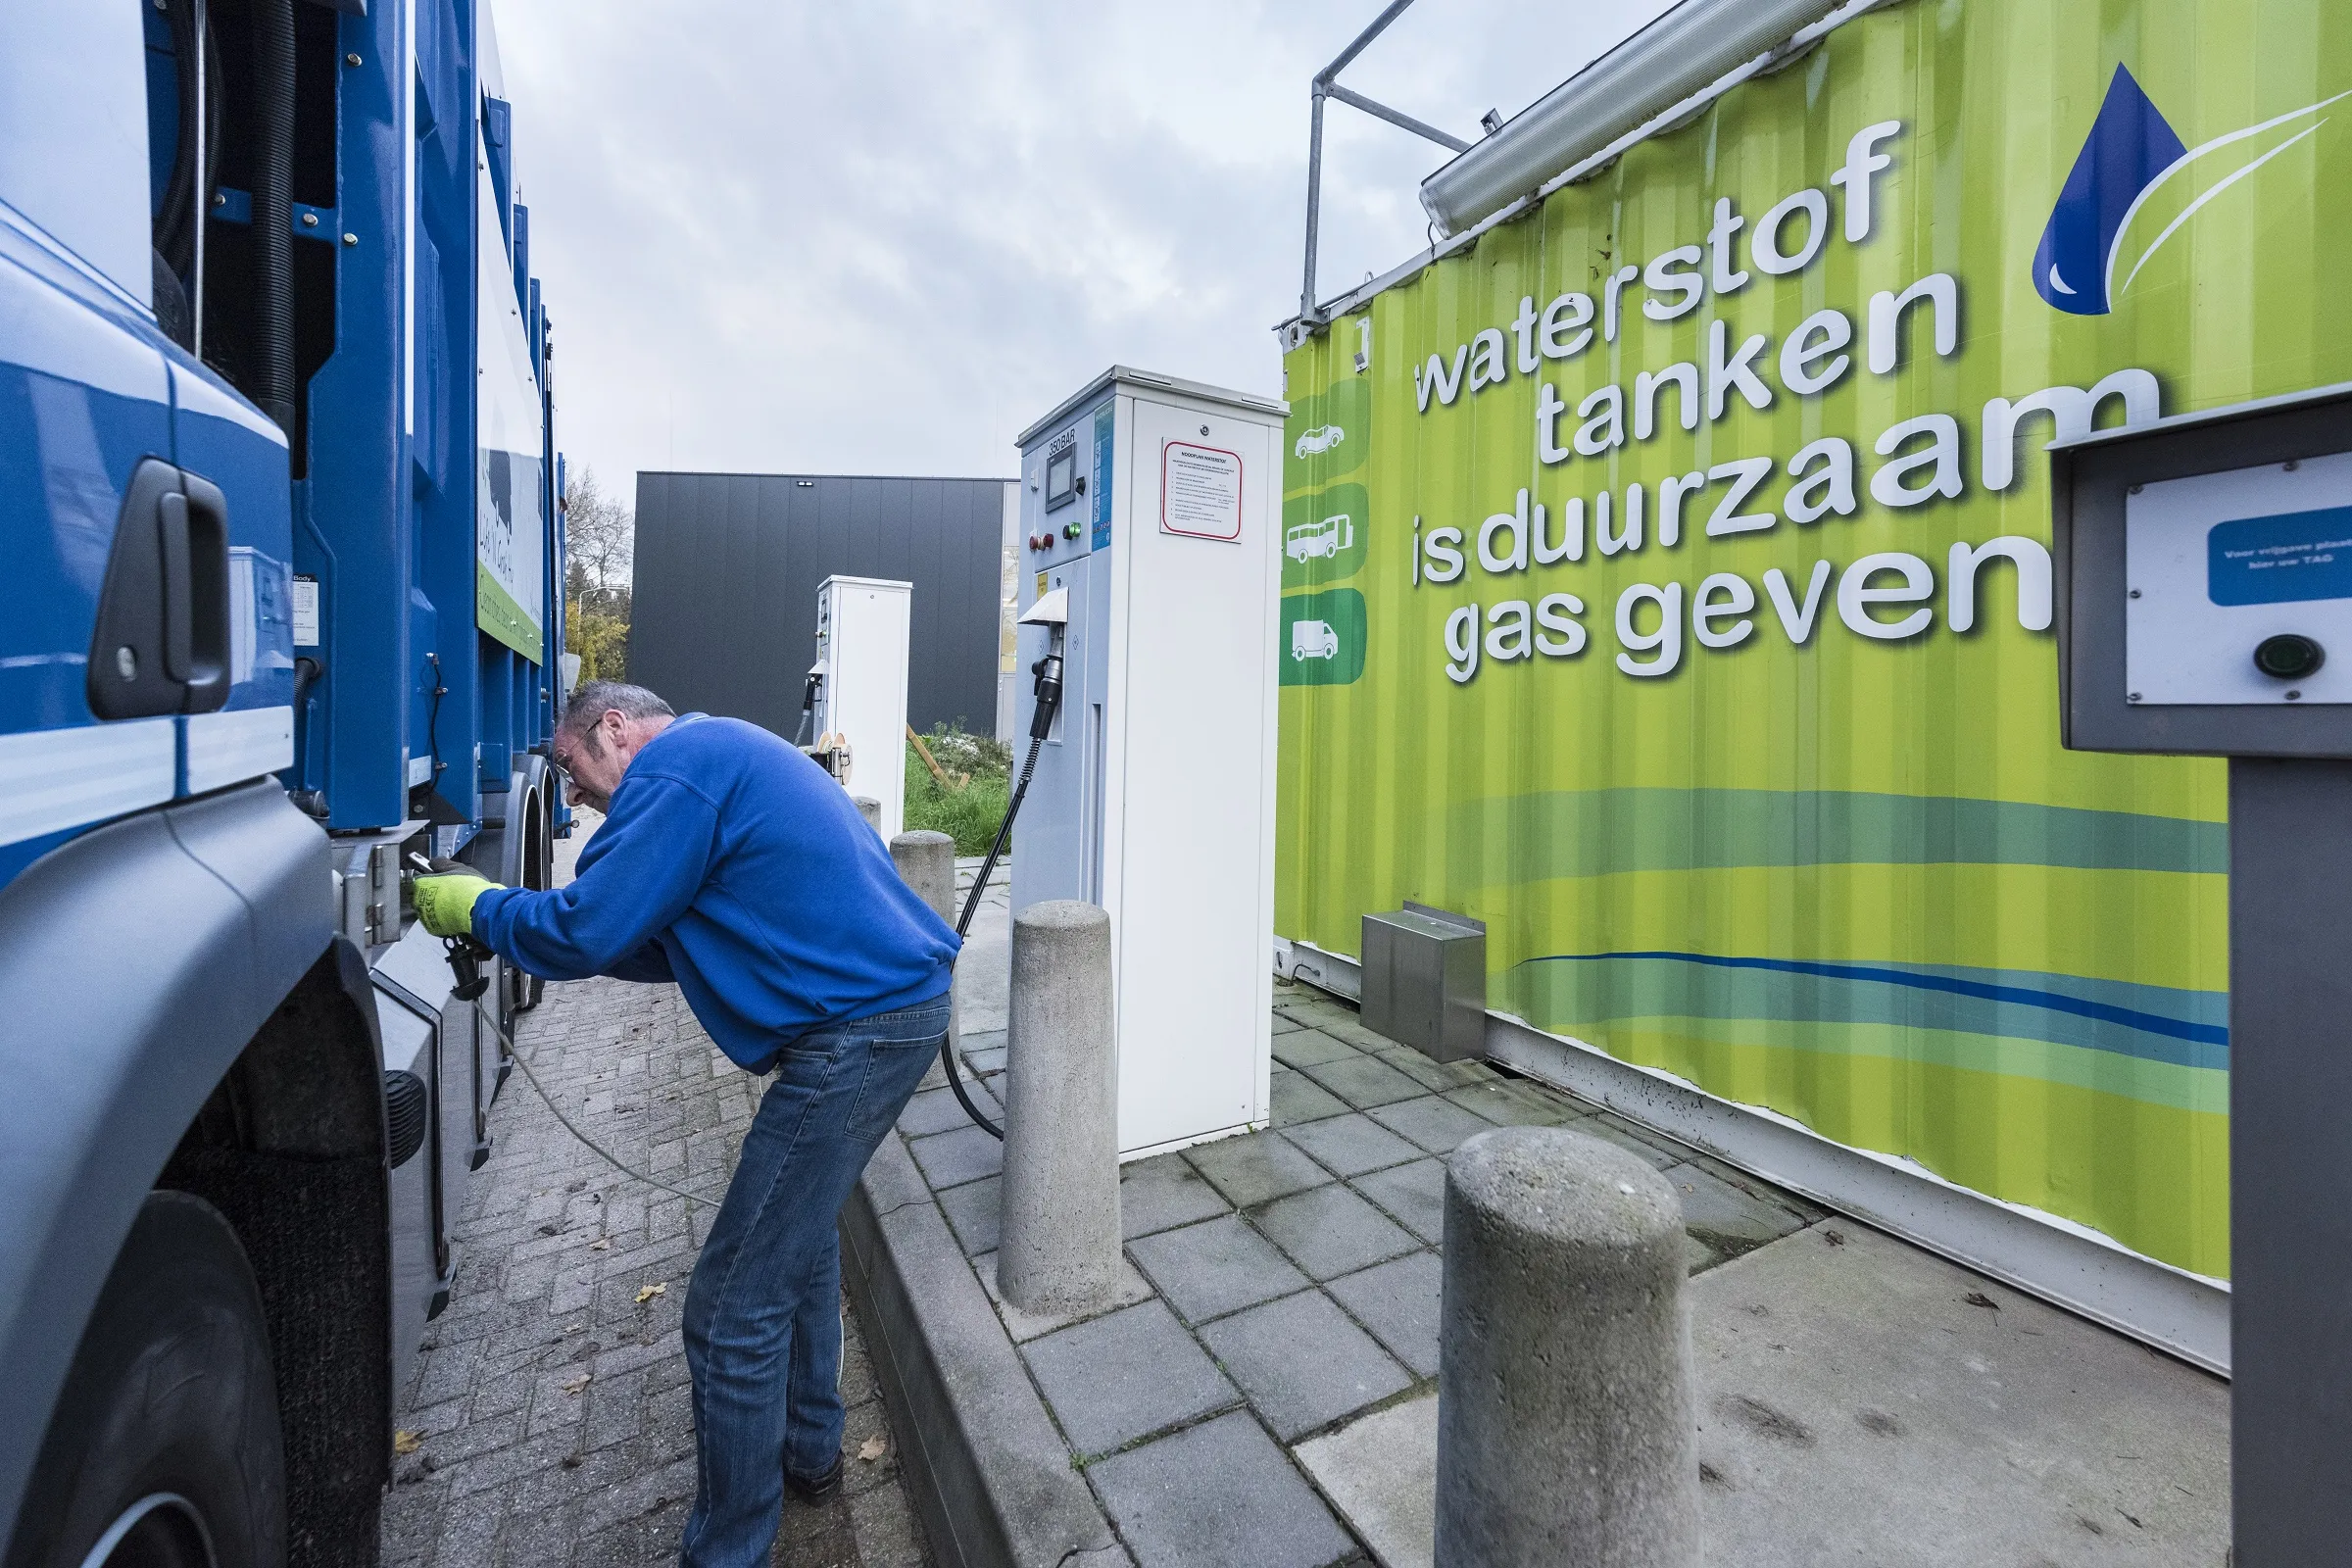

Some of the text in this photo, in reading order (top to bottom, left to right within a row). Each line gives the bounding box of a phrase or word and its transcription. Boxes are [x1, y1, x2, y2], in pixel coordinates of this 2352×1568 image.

[1414, 119, 1901, 414] waterstof
[1049, 437, 1060, 456] 350
[1060, 428, 1075, 449] BAR
[1536, 272, 1958, 465] tanken
[1413, 368, 2161, 587] is duurzaam
[2258, 545, 2312, 556] vrijgave
[2315, 539, 2352, 550] plaat
[1444, 535, 2053, 684] gas geven
[2248, 561, 2275, 570] hier
[2302, 554, 2333, 564] TAG
